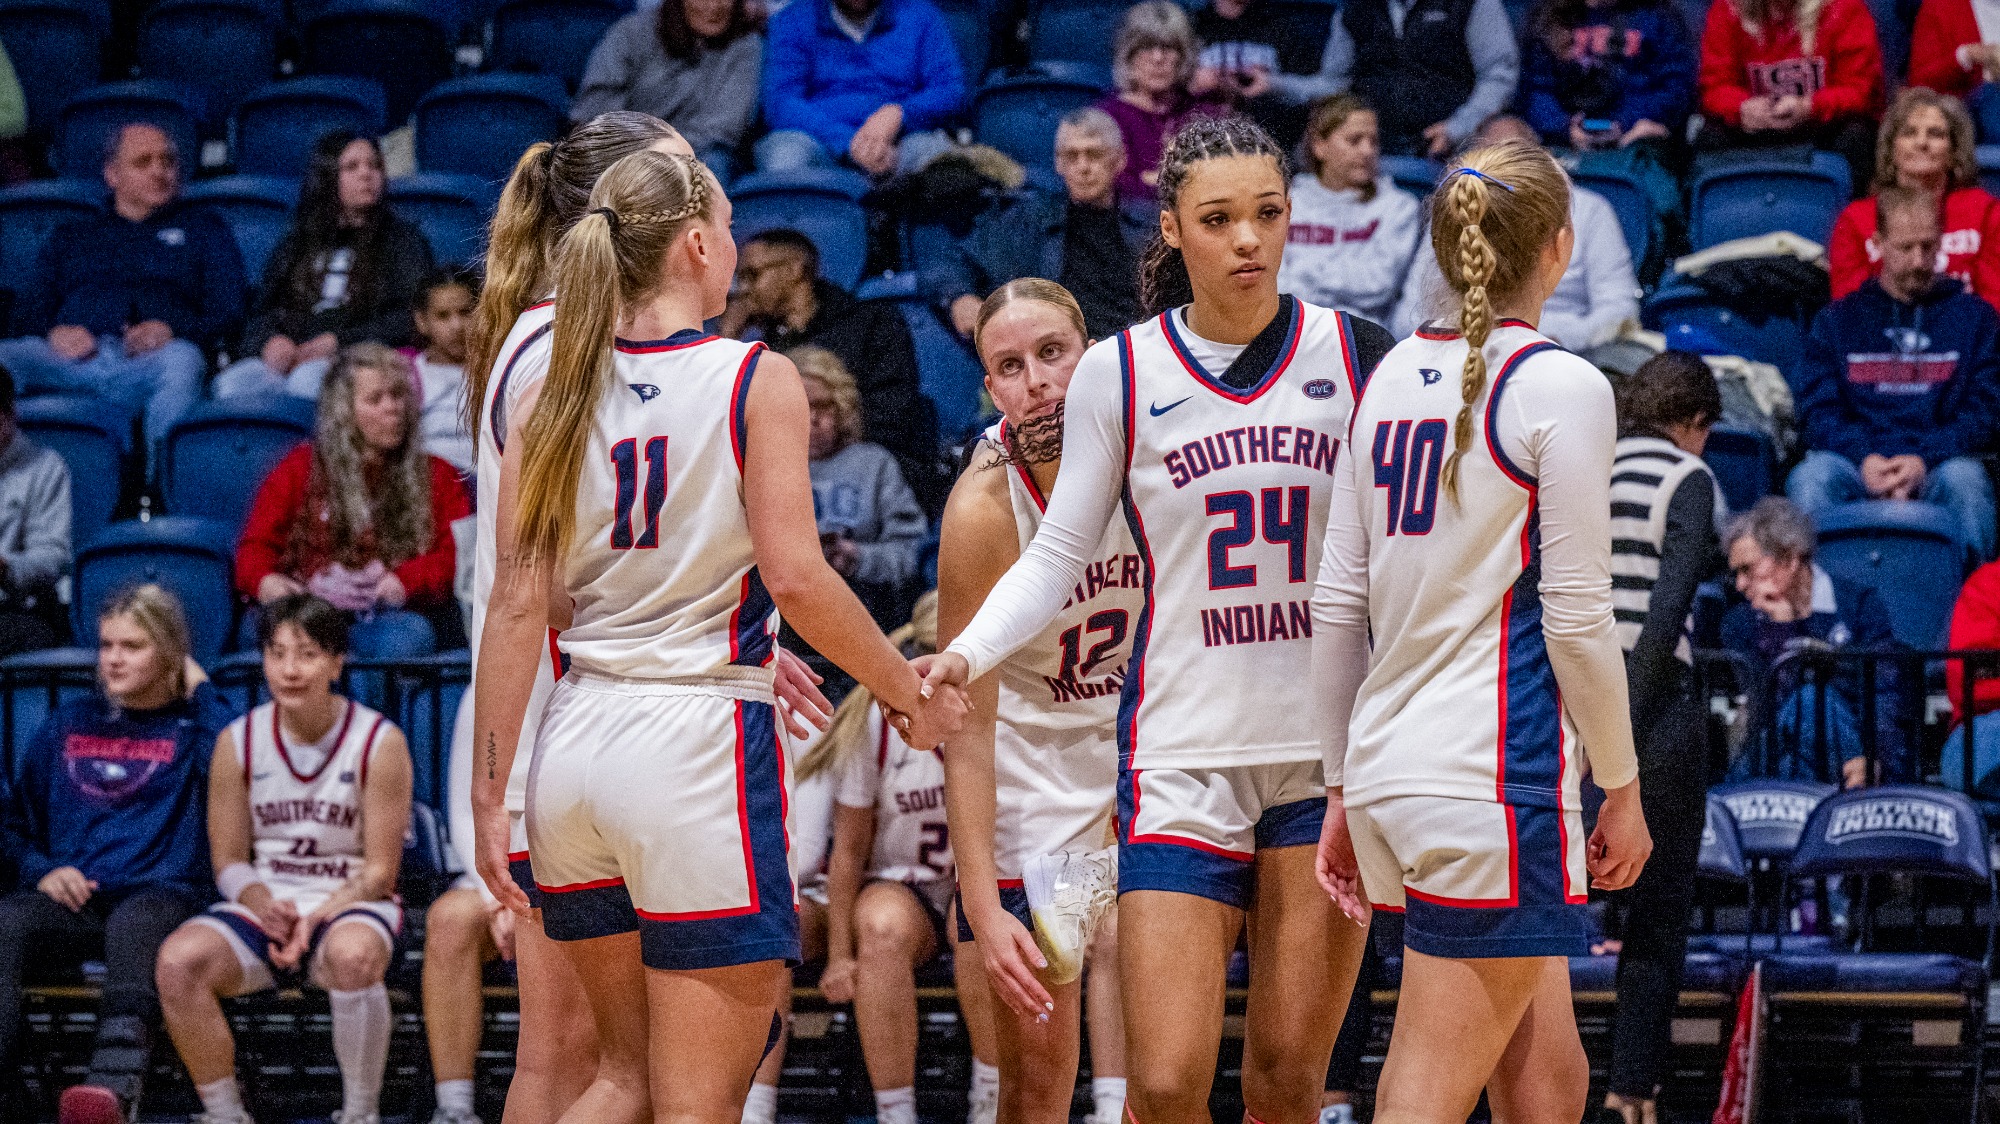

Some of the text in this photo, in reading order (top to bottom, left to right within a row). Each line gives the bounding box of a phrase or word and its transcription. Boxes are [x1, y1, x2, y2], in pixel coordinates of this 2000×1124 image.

[1163, 425, 1341, 489] SOUTHERN
[1371, 418, 1448, 537] 40
[610, 435, 669, 550] 11
[1205, 485, 1310, 591] 24
[1059, 608, 1129, 684] 12
[1200, 600, 1313, 648] INDIAN
[255, 798, 359, 828] SOUTHERN
[1831, 813, 1956, 841] INDIANA
[1836, 799, 1955, 823] SOUTHERN
